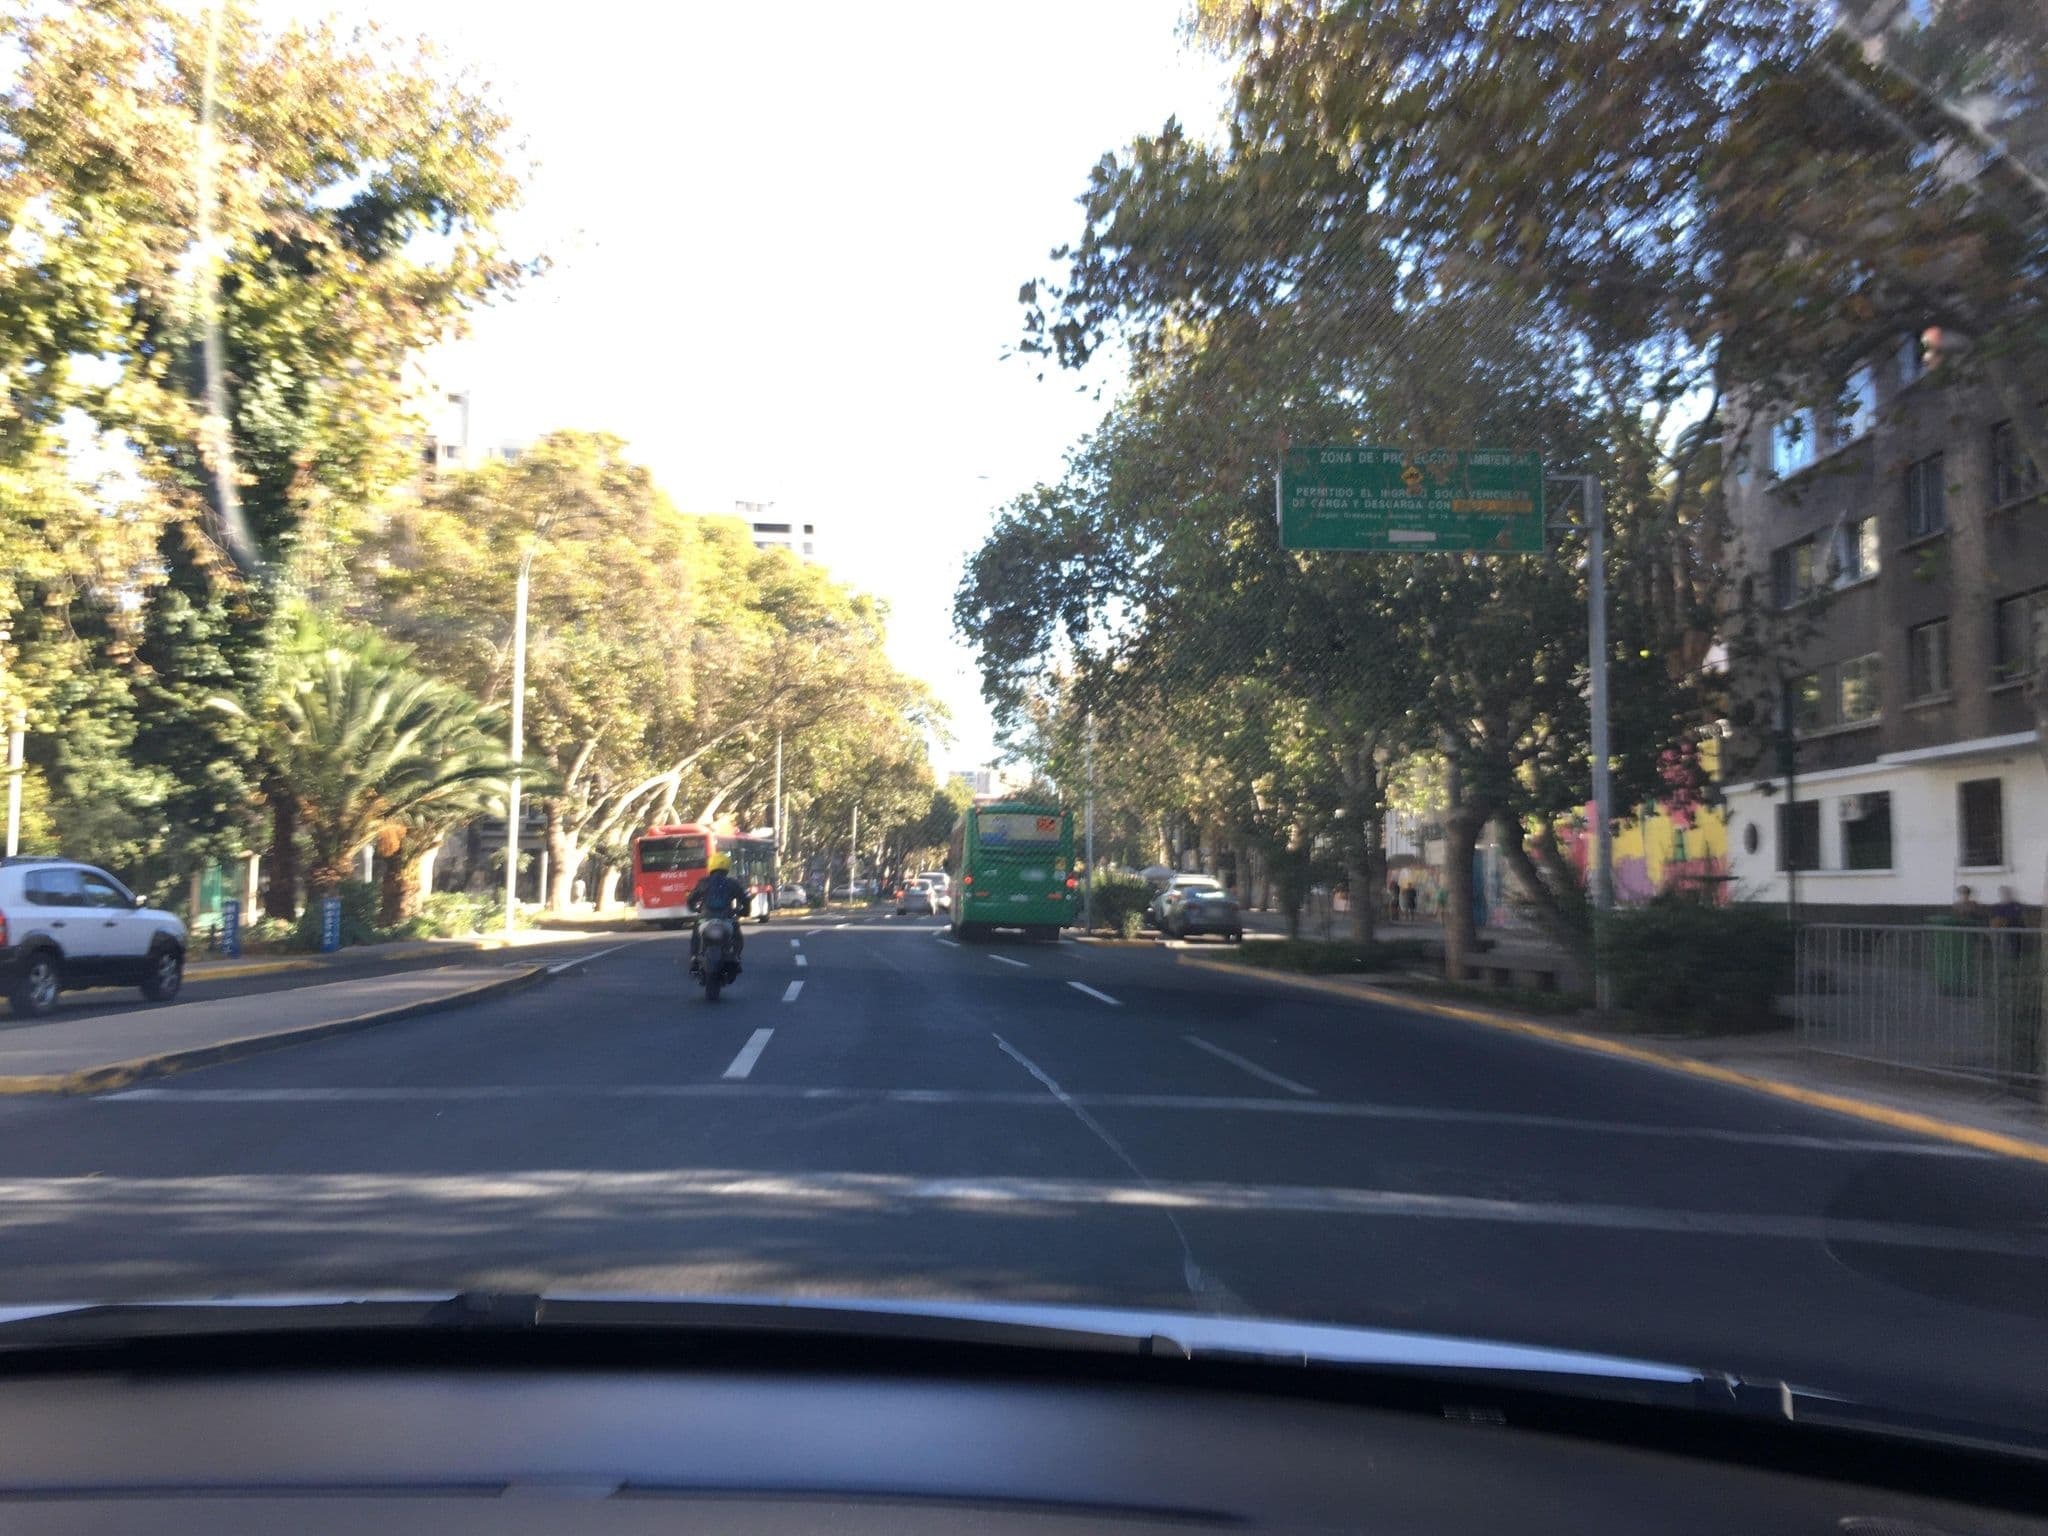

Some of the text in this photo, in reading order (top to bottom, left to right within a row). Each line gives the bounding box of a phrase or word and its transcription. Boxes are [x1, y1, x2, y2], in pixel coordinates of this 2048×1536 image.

[1320, 452, 1352, 464] ZONA
[1358, 452, 1375, 464] DE
[1383, 452, 1458, 466] PROECCION
[1296, 487, 1353, 498] PERMITIDO
[1360, 488, 1372, 498] EL
[1311, 499, 1349, 509] CARGA
[1353, 499, 1360, 509] Y
[1364, 499, 1424, 510] DESCARGA
[1428, 500, 1451, 510] CON
